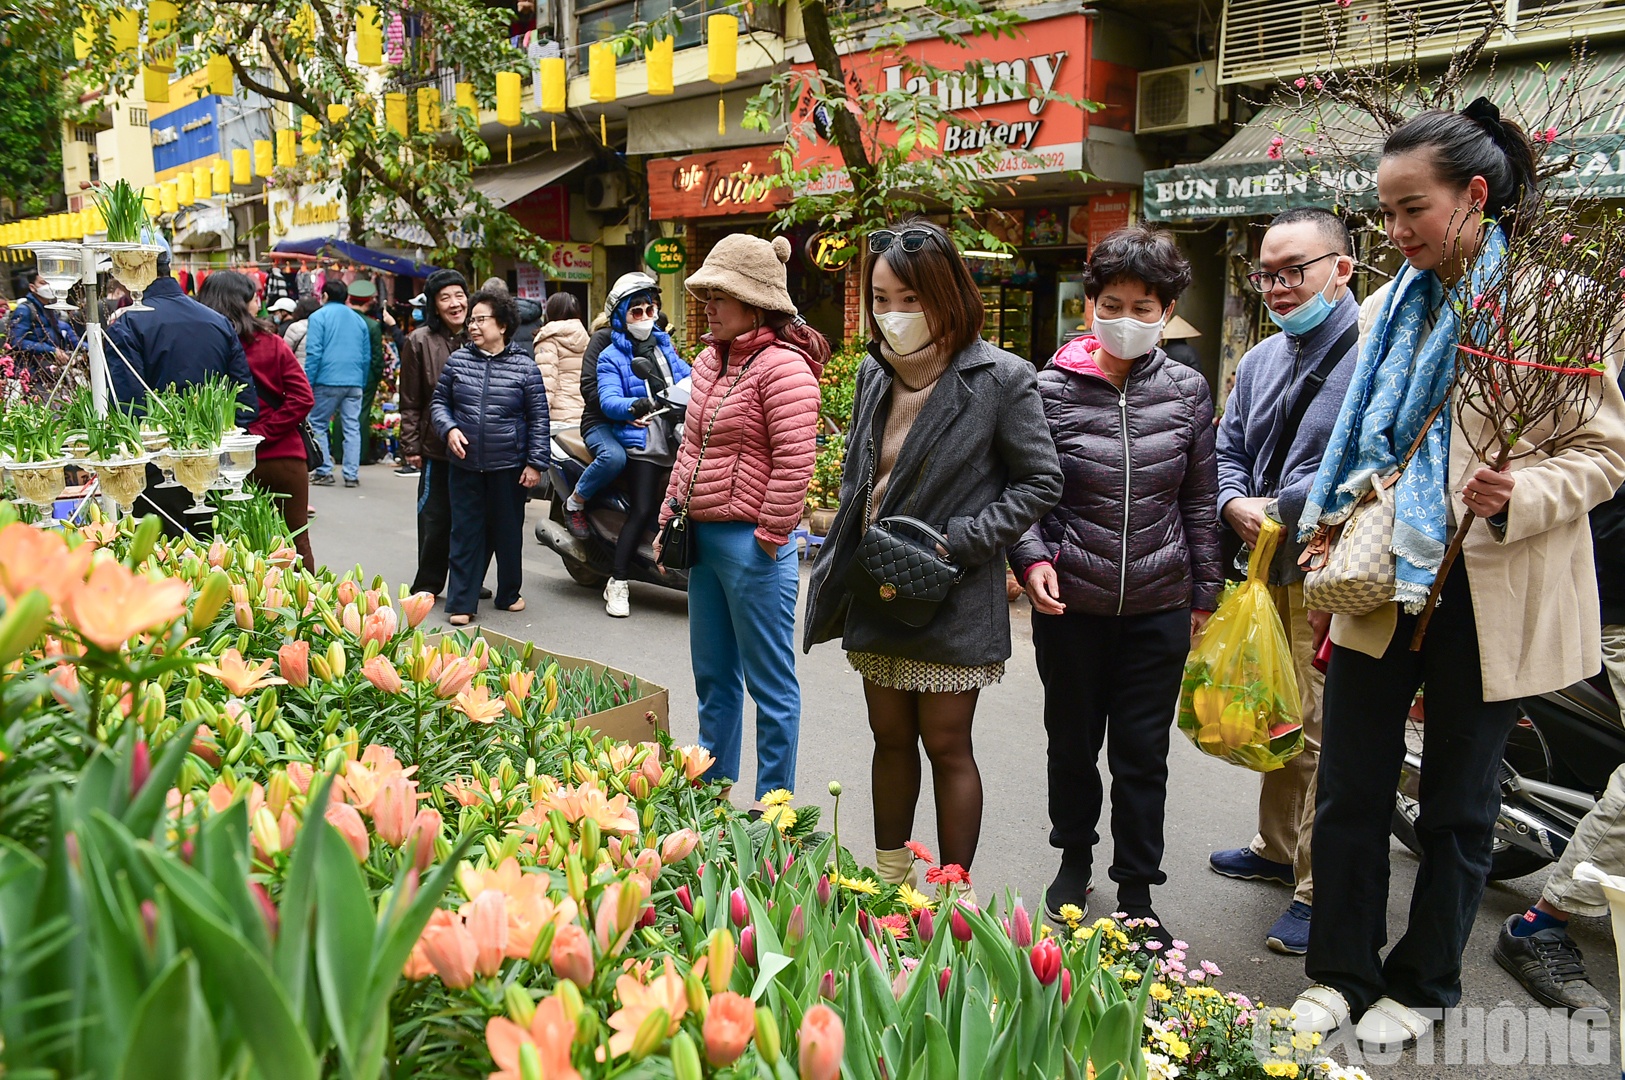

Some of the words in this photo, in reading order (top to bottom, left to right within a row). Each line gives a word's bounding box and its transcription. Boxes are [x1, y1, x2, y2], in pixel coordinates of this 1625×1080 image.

[943, 119, 1042, 152] Bakery
[826, 174, 837, 190] 37
[1156, 174, 1218, 203] BÚN
[1318, 167, 1378, 197] MỌ
